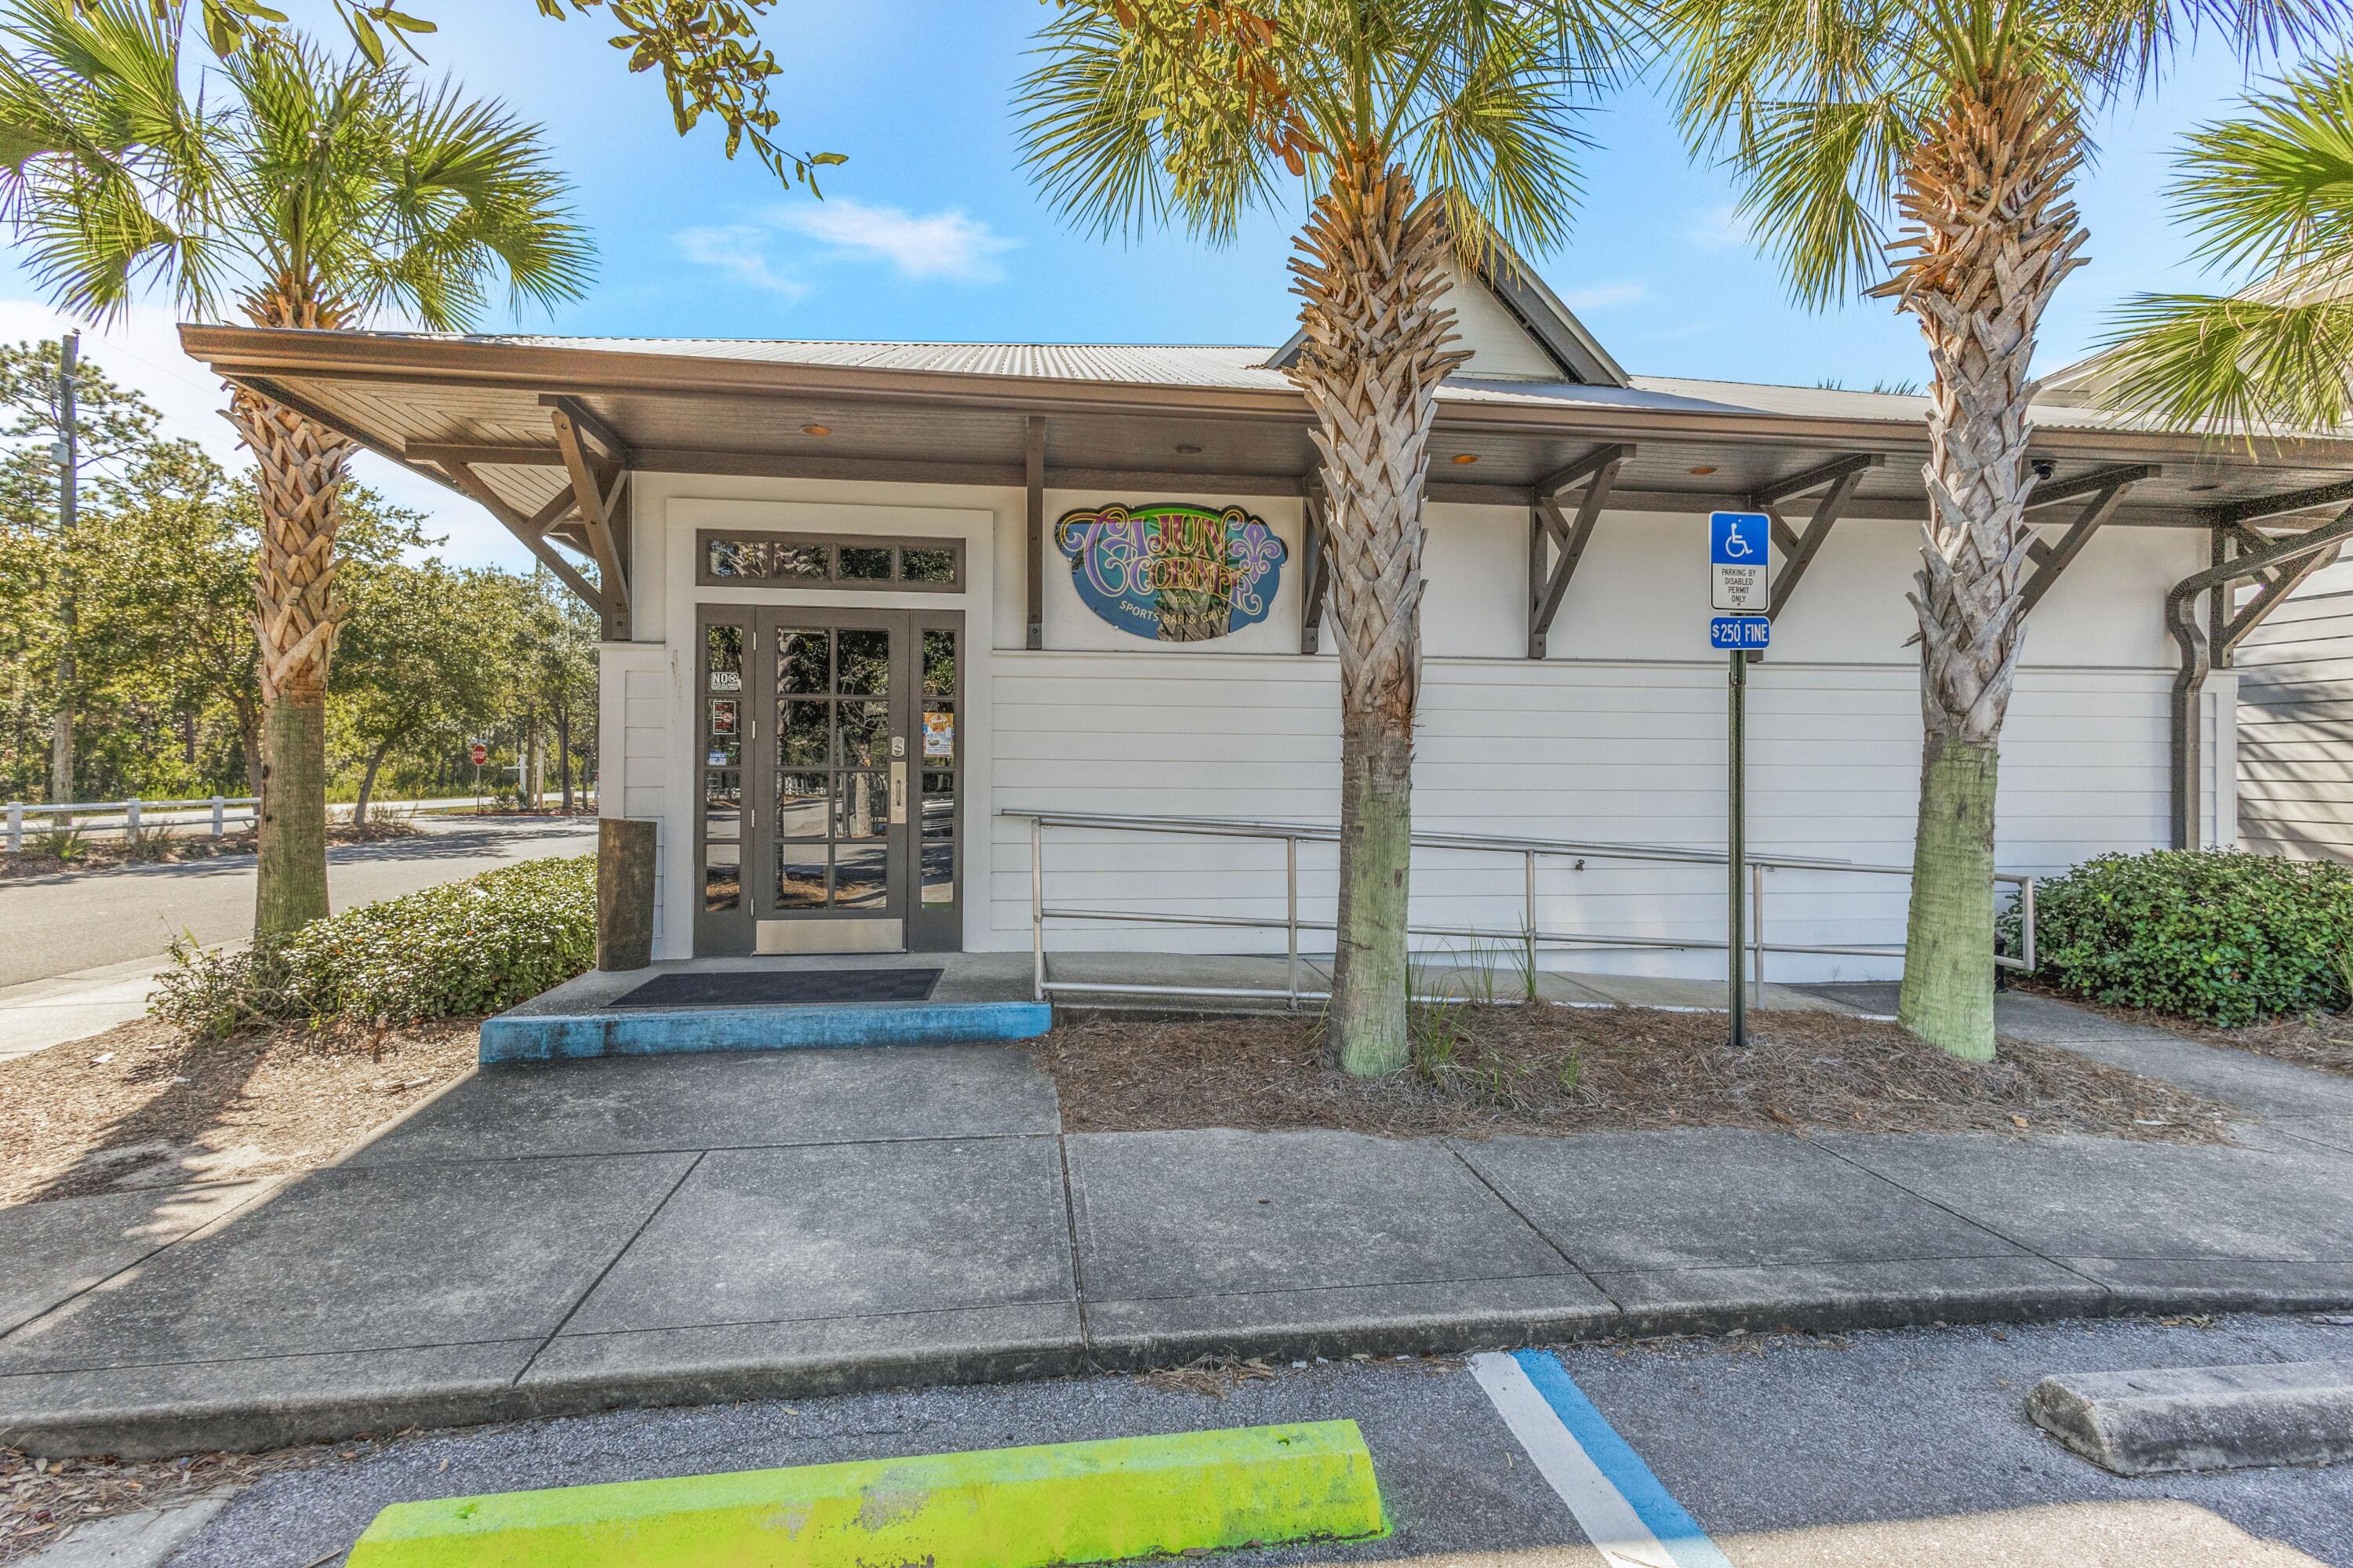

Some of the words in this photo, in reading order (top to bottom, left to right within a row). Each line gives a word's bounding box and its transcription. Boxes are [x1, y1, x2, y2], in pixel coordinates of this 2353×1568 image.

[1060, 507, 1246, 597] CAJUN
[1722, 568, 1747, 577] PARKING
[1748, 569, 1757, 577] BY
[1128, 556, 1263, 616] CORNER
[1725, 577, 1754, 586] DISABLED
[1728, 586, 1750, 595] PERMIT
[1118, 600, 1160, 622] SPORTS
[1163, 614, 1184, 624] BAR
[1188, 614, 1197, 624] &
[1200, 606, 1231, 623] GRILL
[1744, 624, 1768, 642] FINE
[713, 674, 728, 682] NO
